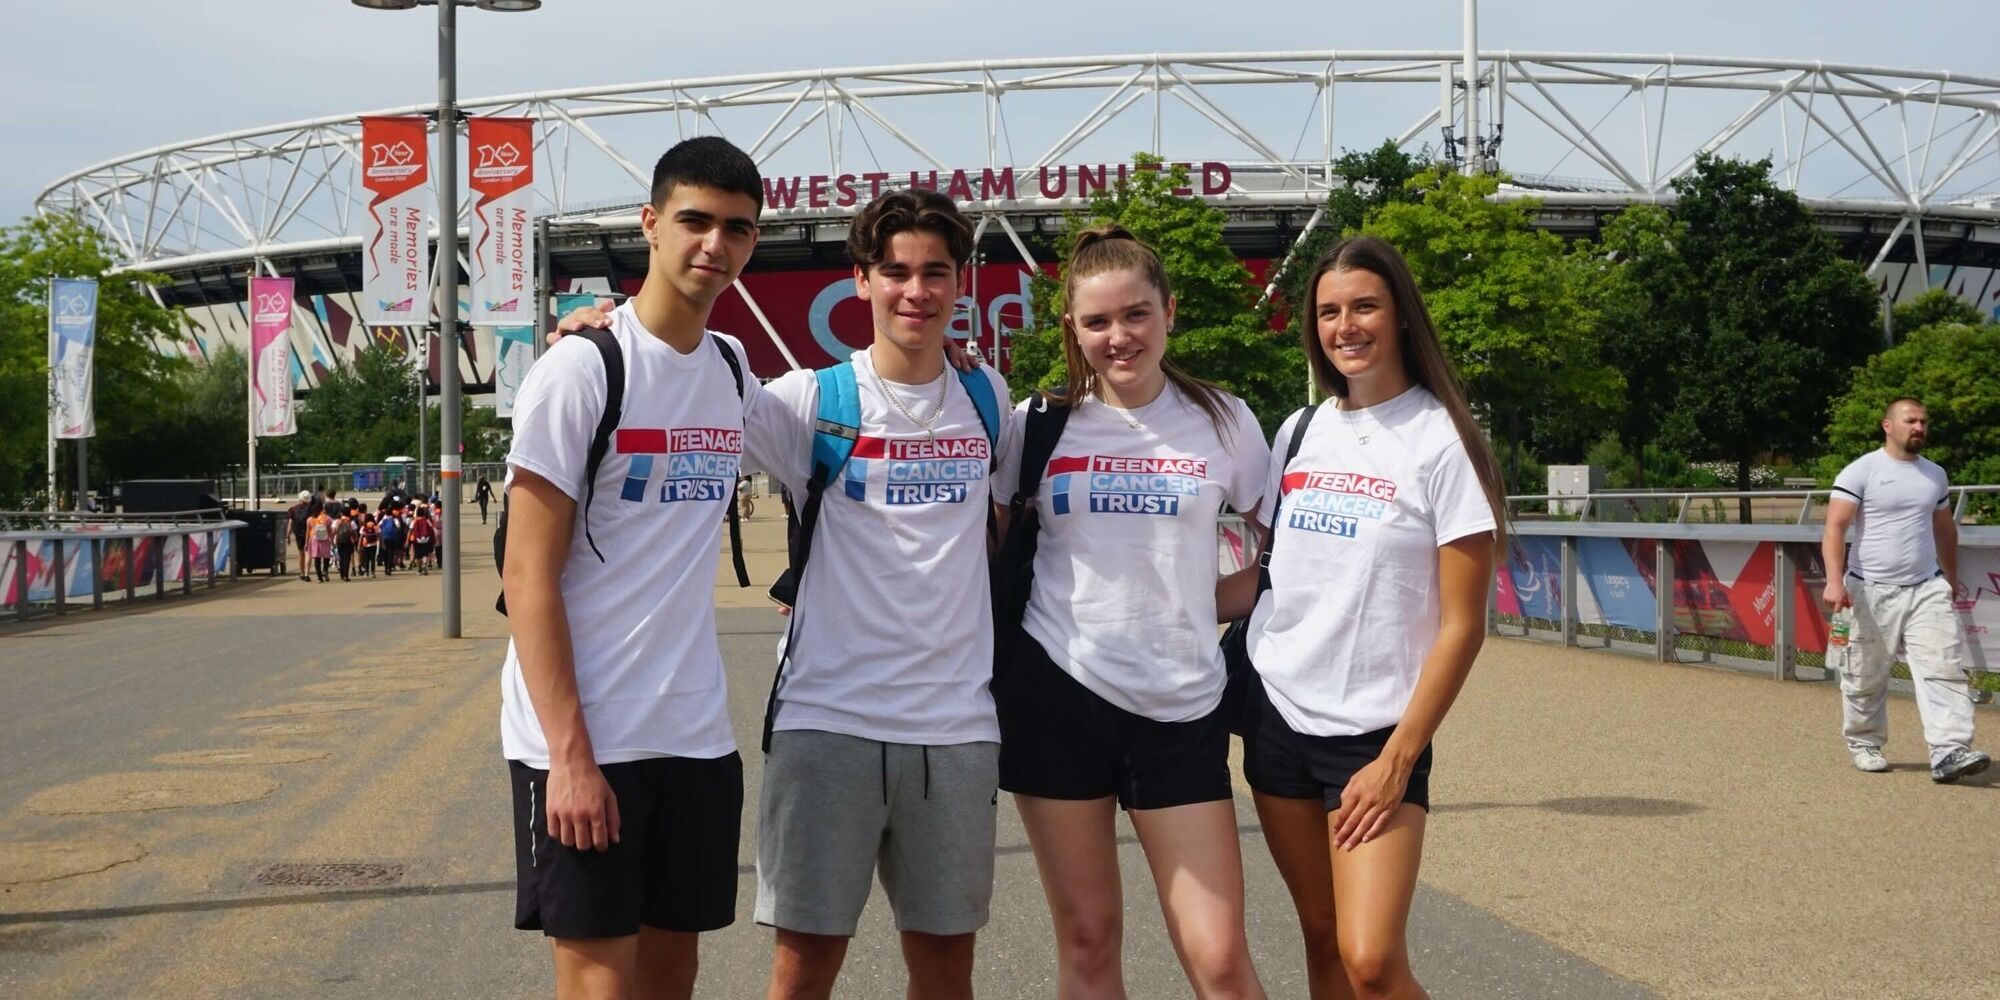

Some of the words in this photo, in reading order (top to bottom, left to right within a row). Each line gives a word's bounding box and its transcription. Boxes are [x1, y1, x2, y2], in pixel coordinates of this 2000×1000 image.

[763, 172, 889, 209] WEST
[910, 168, 1015, 201] HAM
[389, 207, 398, 227] are
[495, 207, 504, 227] are
[389, 232, 401, 264] made
[406, 207, 421, 292] Memories
[495, 232, 507, 265] made
[512, 207, 527, 292] Memories
[671, 429, 743, 452] TEENAGE
[892, 439, 988, 459] TEENAGE
[669, 454, 737, 476] CANCER
[890, 461, 982, 481] CANCER
[1096, 456, 1207, 477] TEENAGE
[662, 480, 723, 500] TRUST
[888, 485, 965, 503] TRUST
[1092, 474, 1198, 495] CANCER
[1310, 472, 1396, 500] TEENAGE
[1091, 494, 1177, 514] TRUST
[1298, 490, 1381, 518] CANCER
[1293, 509, 1357, 536] TRUST
